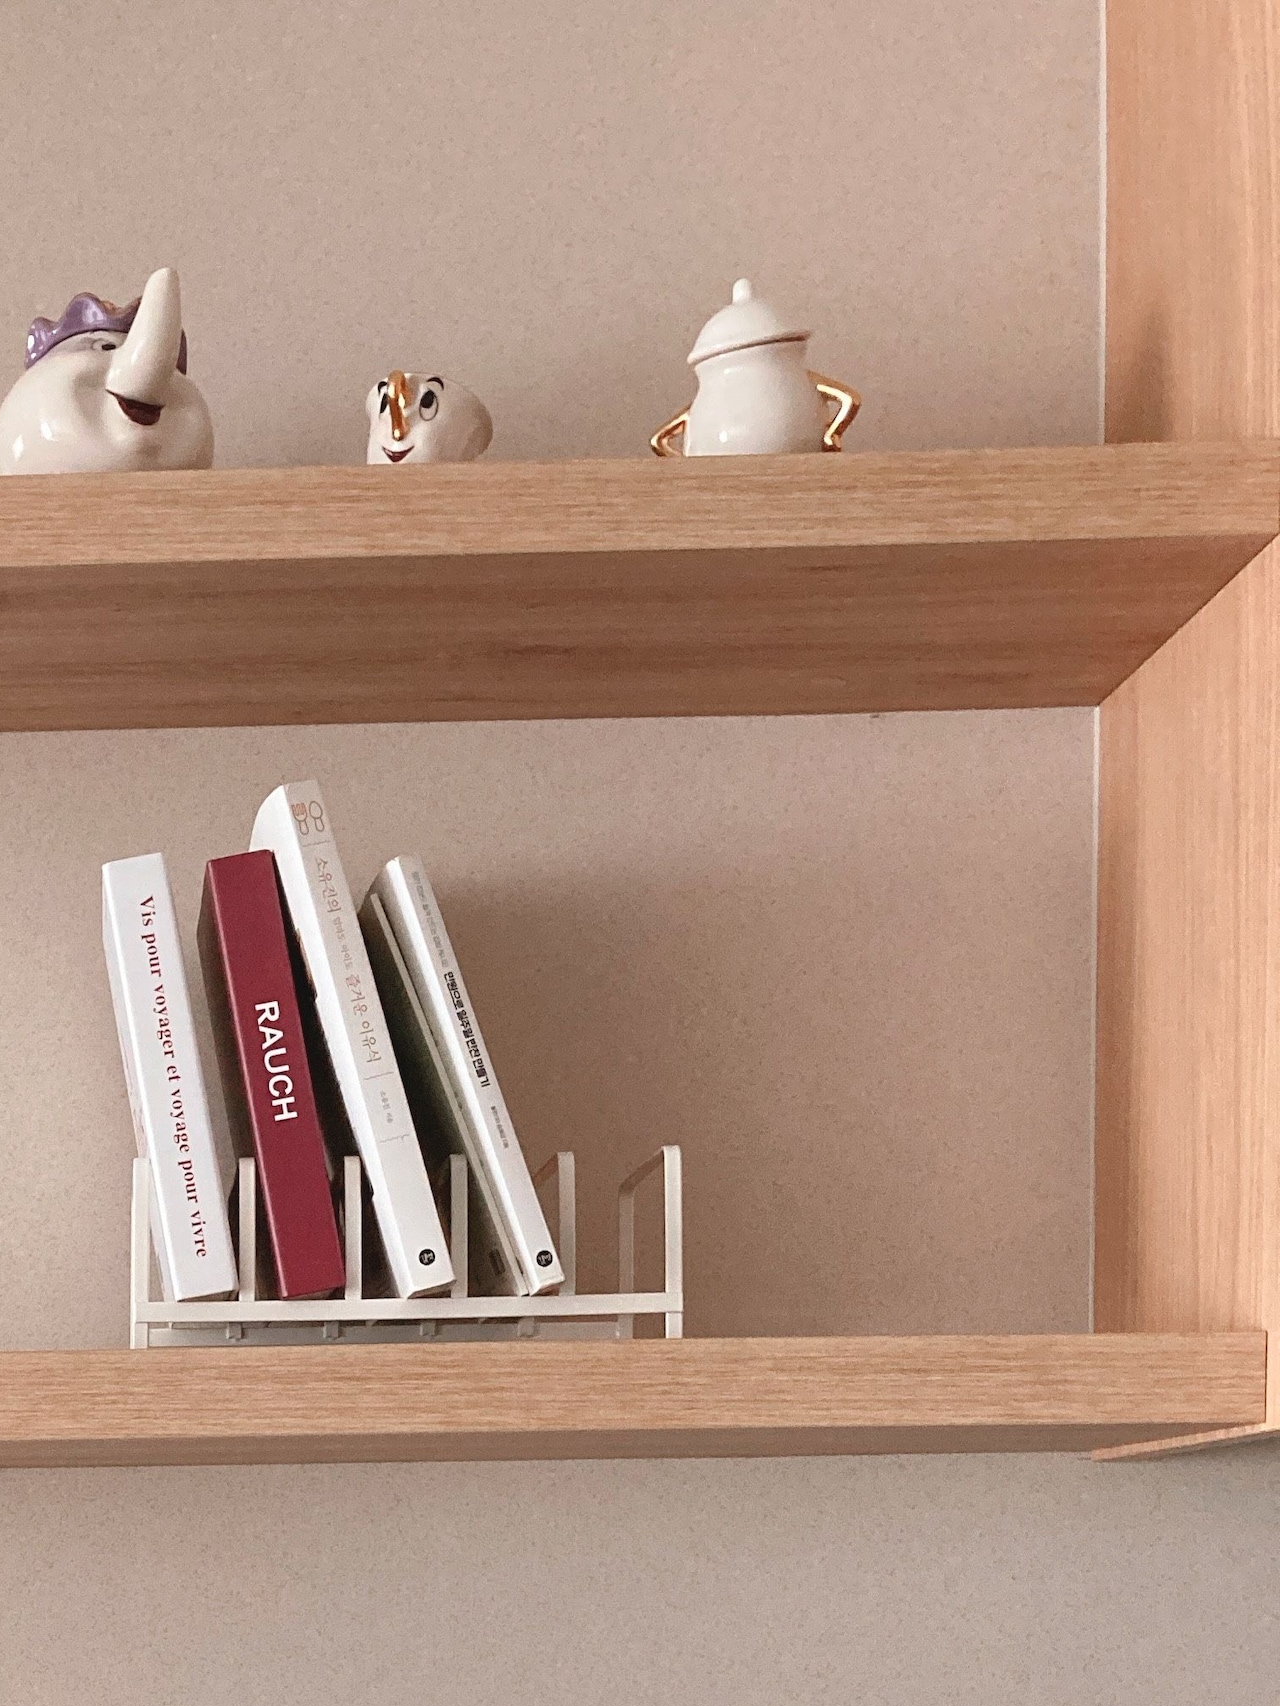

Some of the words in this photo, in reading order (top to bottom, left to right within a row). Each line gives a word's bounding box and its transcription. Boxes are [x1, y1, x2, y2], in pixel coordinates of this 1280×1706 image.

[139, 895, 156, 927] Vis
[141, 933, 162, 978] pour
[315, 857, 342, 912] 소유진의
[345, 974, 368, 1016] 즐거운
[359, 1020, 382, 1063] 이유식
[153, 984, 175, 1058] voyager
[167, 1065, 181, 1082] et
[254, 1000, 298, 1121] RAUCH
[170, 1088, 190, 1153] voyage
[178, 1159, 198, 1204] pour
[190, 1210, 207, 1257] vivre
